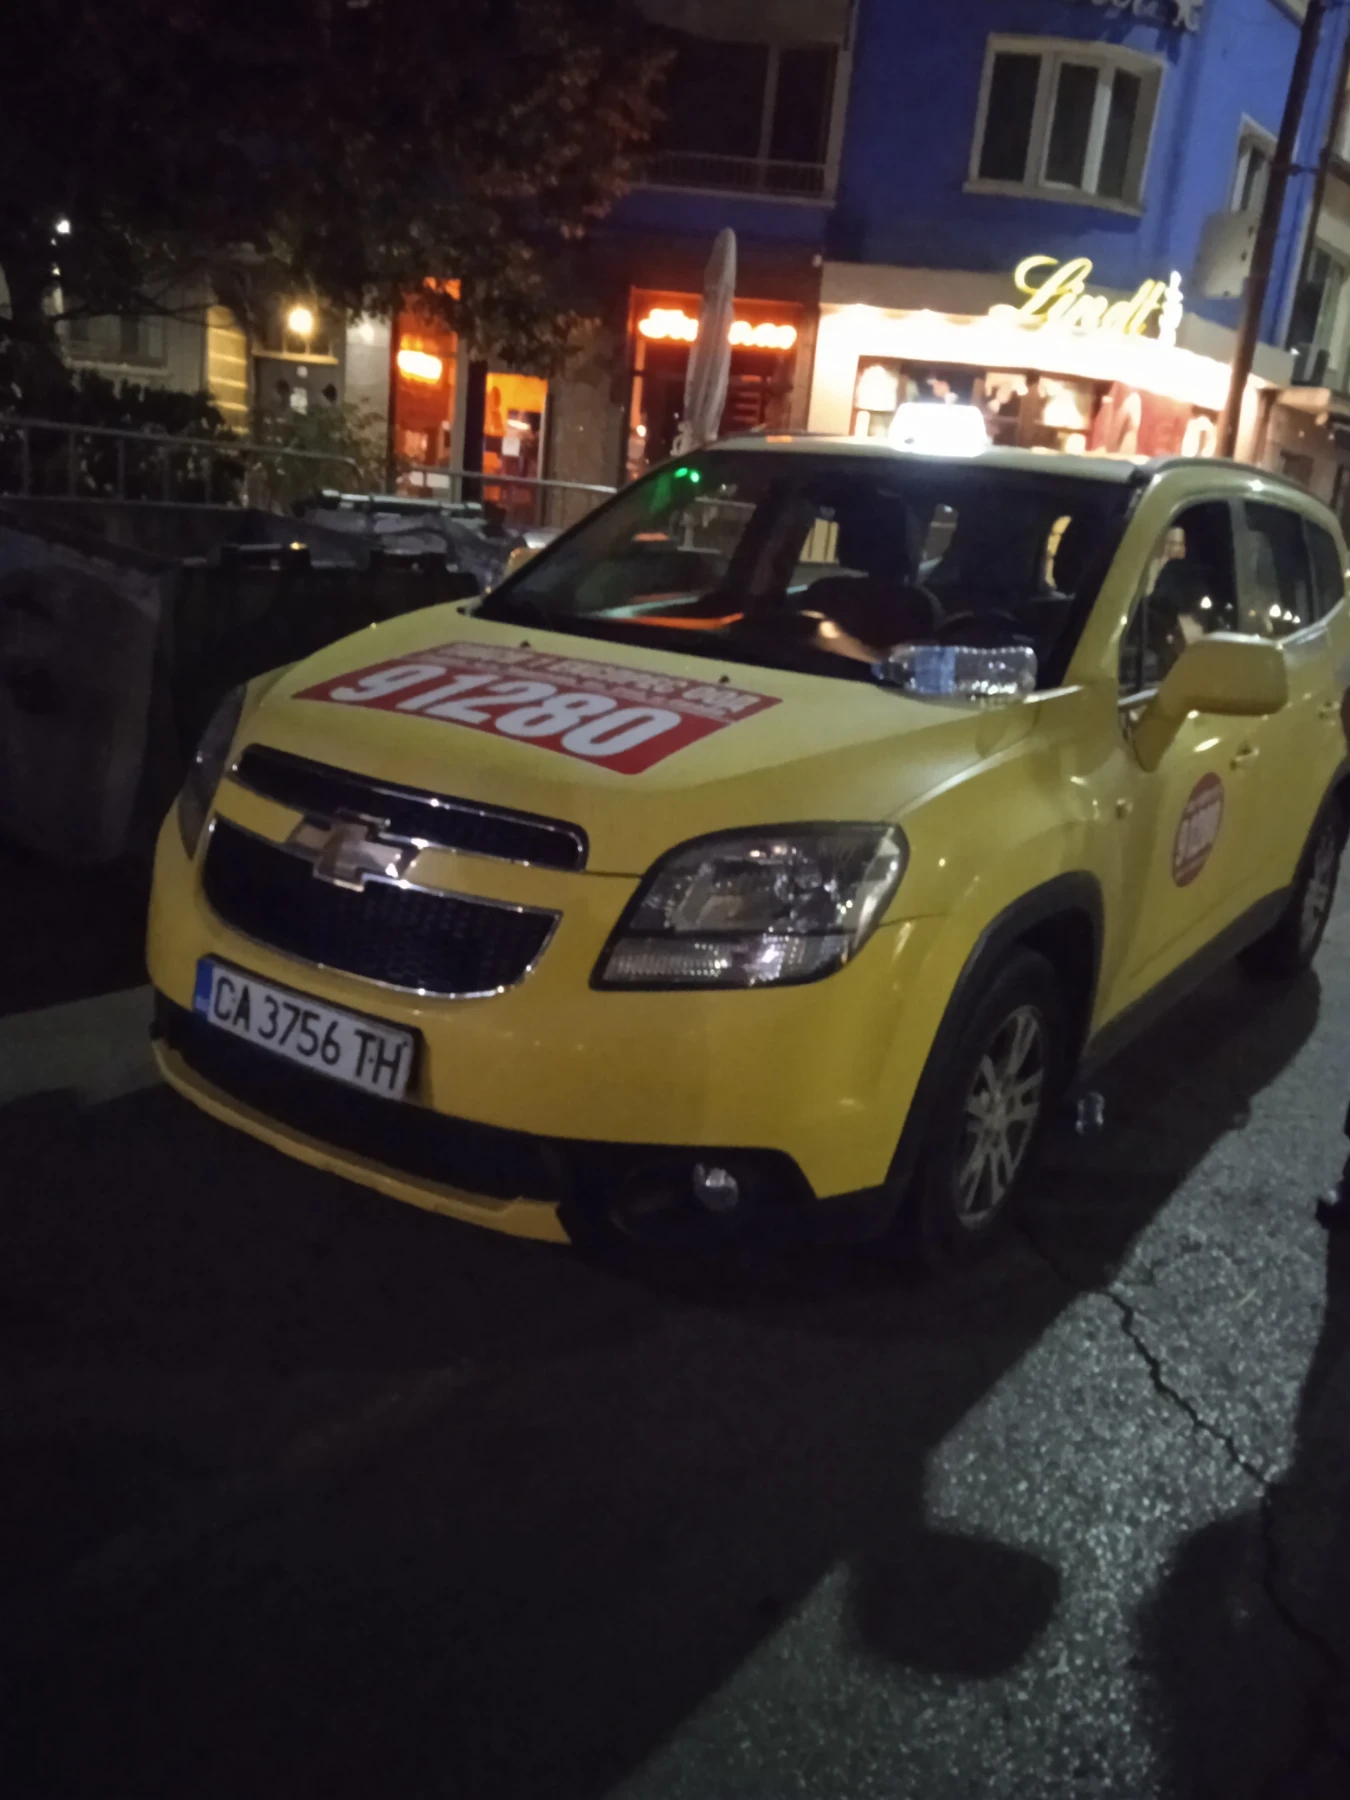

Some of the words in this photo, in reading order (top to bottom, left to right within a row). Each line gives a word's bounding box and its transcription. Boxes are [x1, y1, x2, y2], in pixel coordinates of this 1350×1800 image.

[1014, 255, 1166, 336] Lindt
[329, 664, 682, 757] 91280
[213, 976, 250, 1033] CA
[257, 995, 341, 1066] 3756
[354, 1028, 406, 1091] TH
